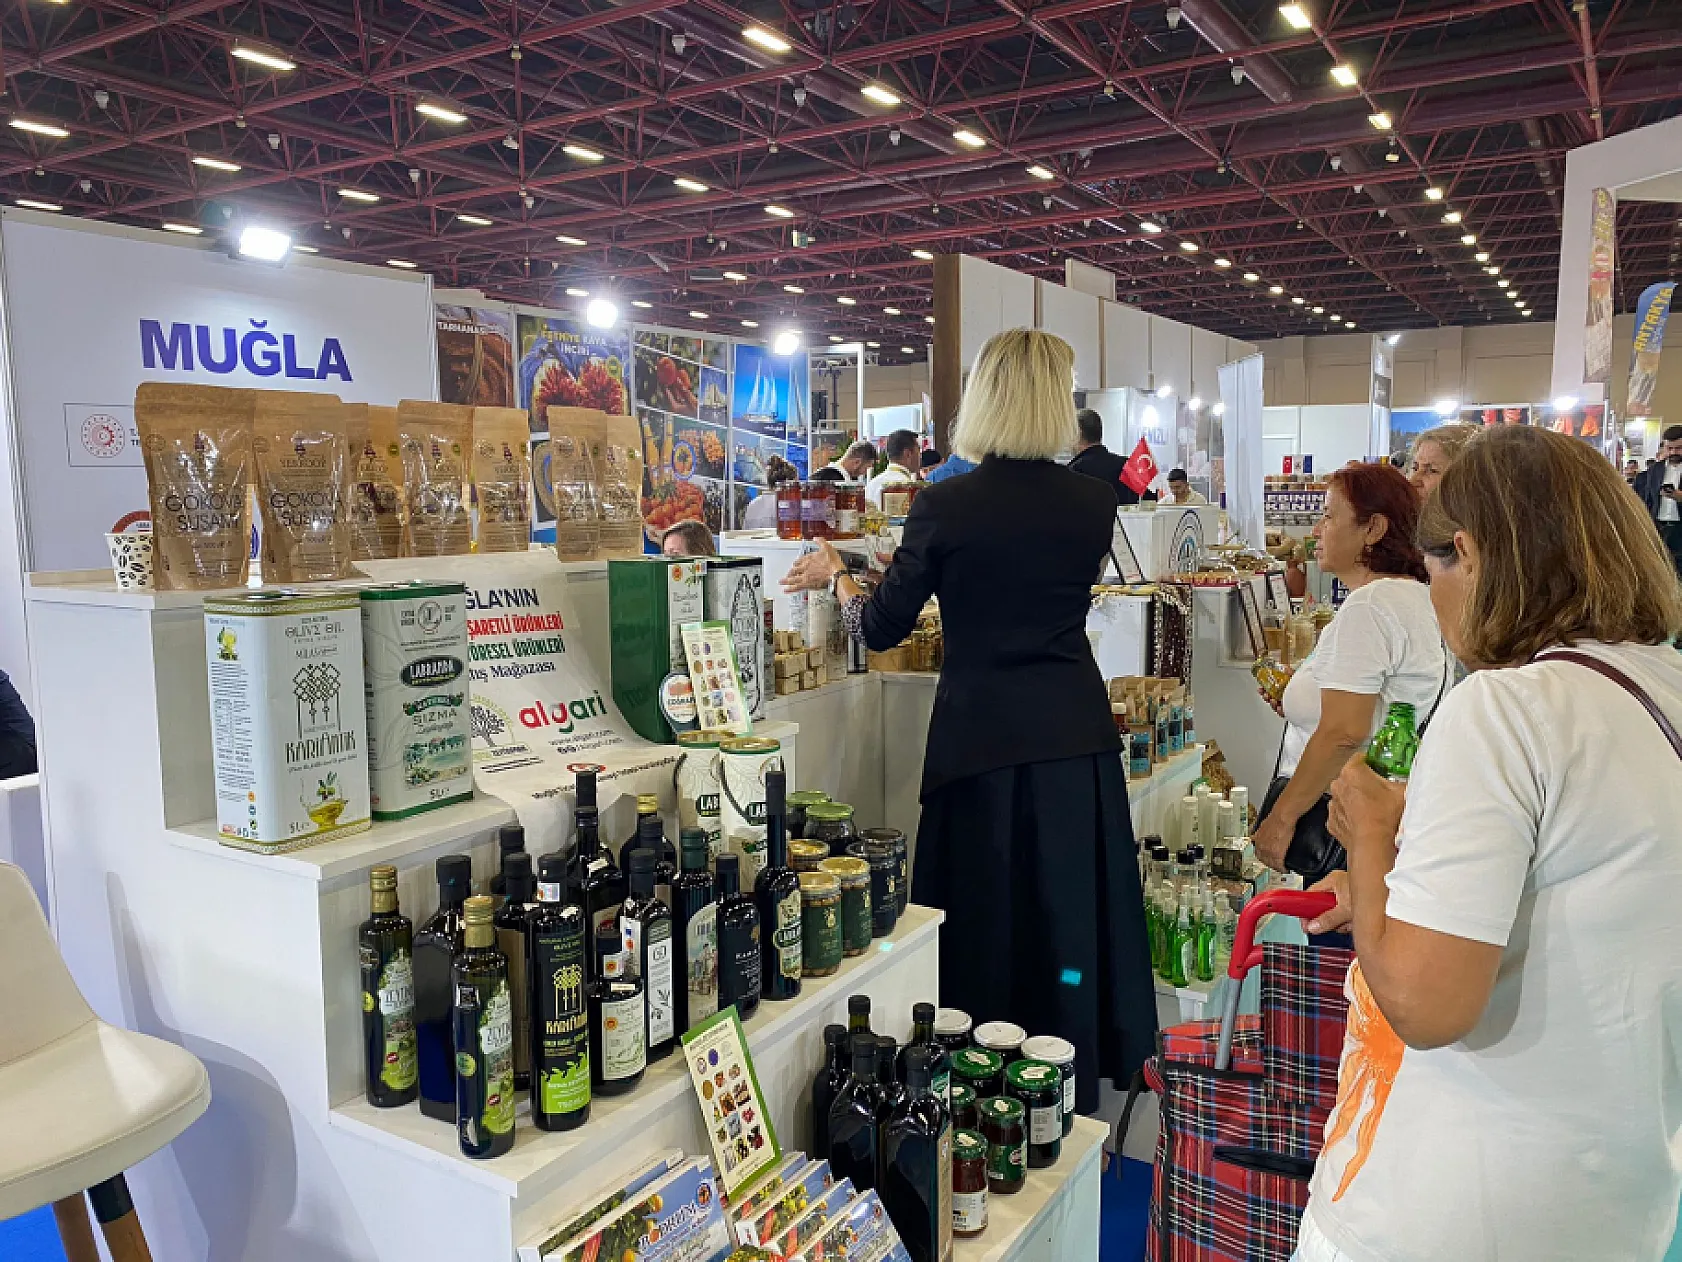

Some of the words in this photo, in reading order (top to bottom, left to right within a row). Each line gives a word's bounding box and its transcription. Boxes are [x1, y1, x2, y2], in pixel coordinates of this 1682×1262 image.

[139, 317, 353, 382] MUĞLA
[512, 610, 564, 633] ÜRÜNLERİ
[513, 634, 566, 658] ÜRÜNLERİ
[490, 661, 556, 680] Mağazası
[518, 689, 608, 734] algari
